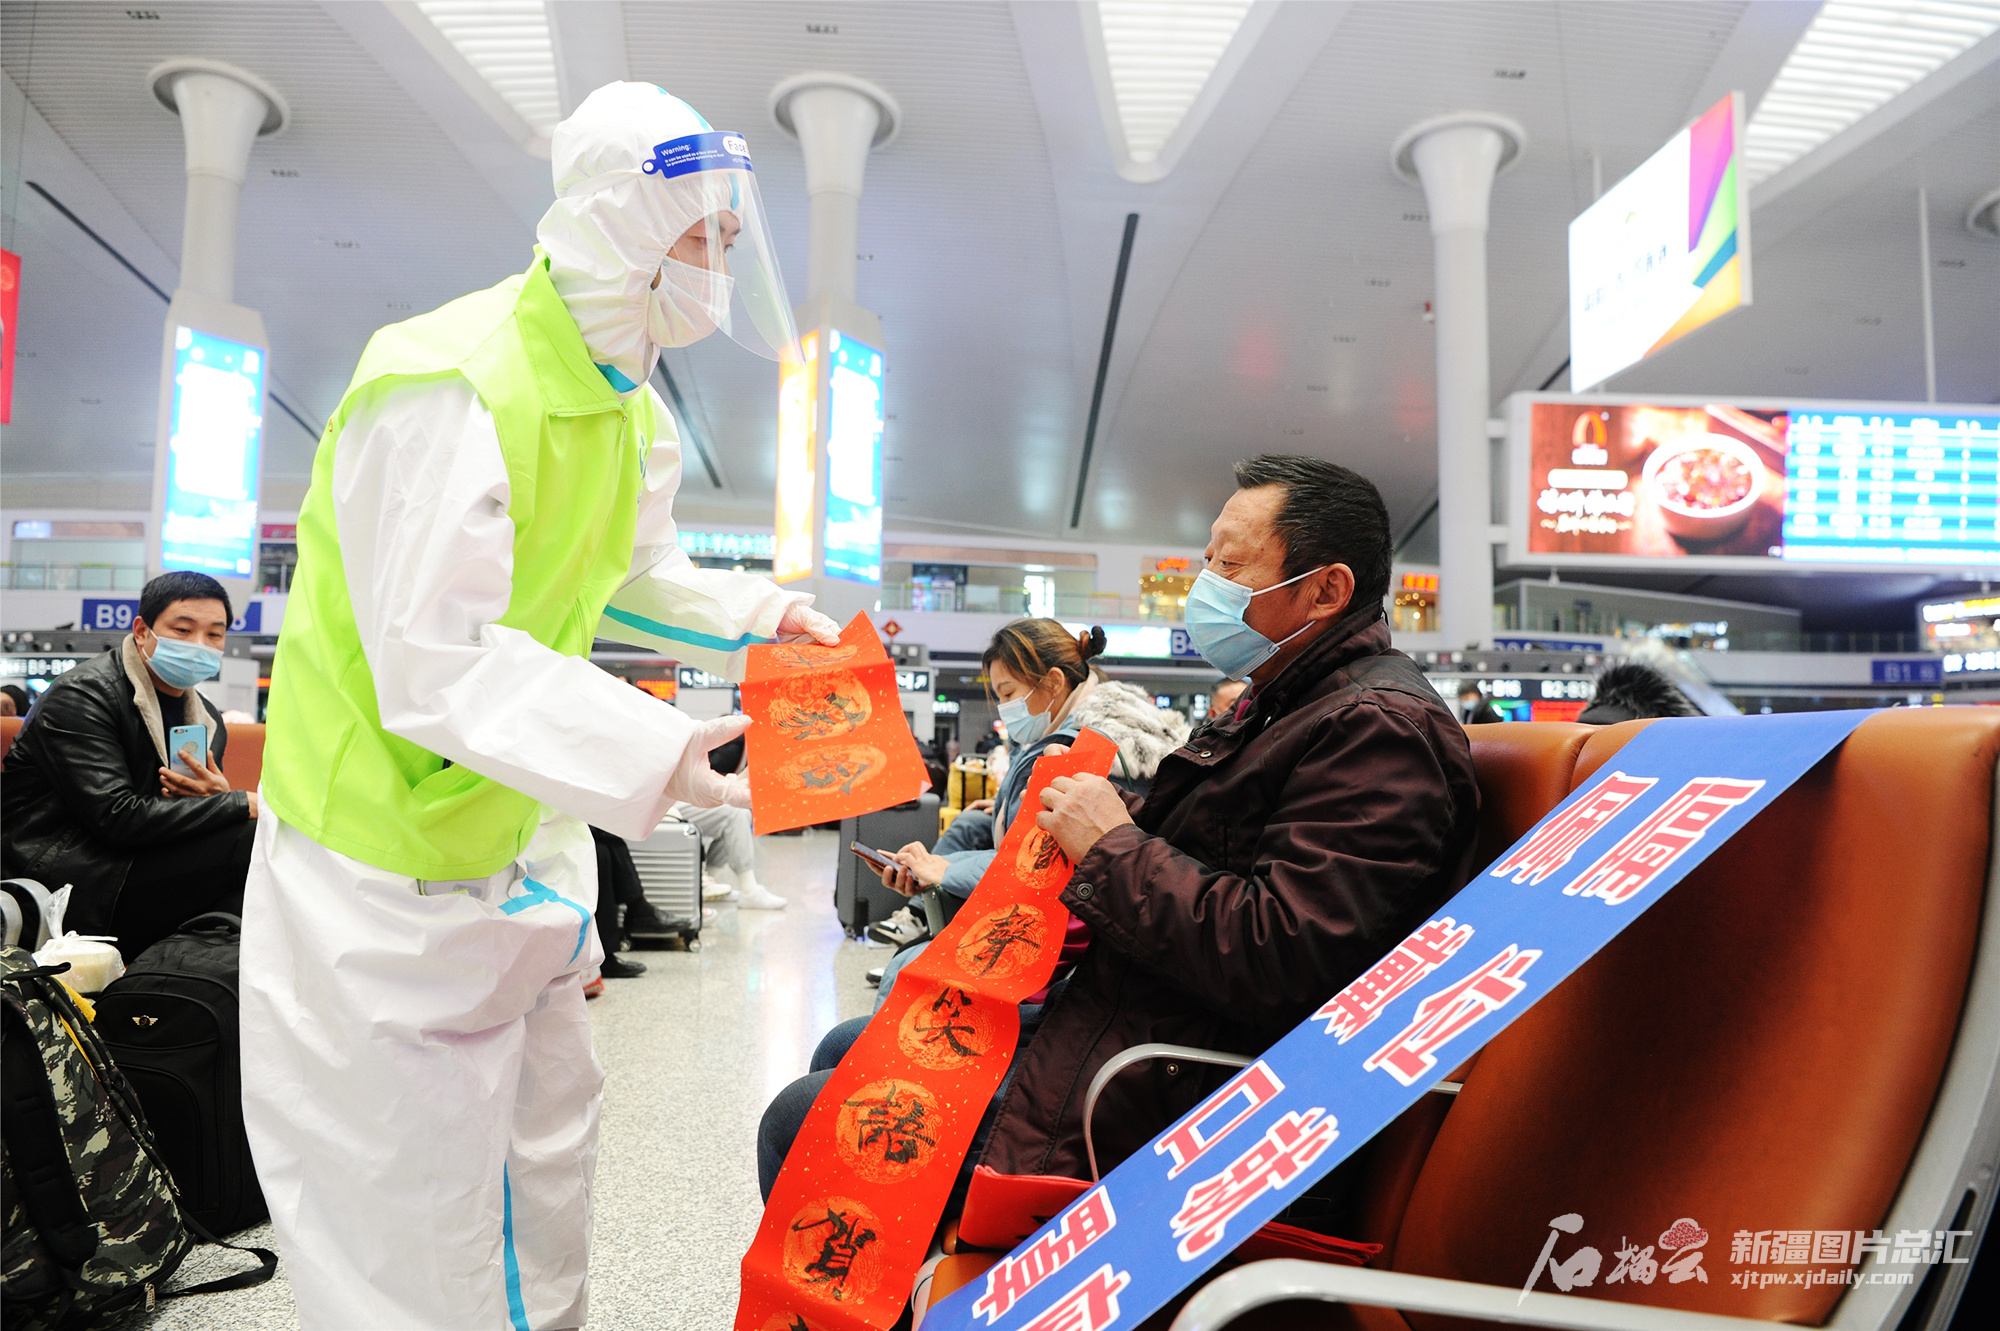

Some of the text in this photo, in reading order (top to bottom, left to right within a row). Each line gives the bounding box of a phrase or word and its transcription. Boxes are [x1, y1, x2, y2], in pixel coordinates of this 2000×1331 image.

[661, 144, 691, 157] Warning:
[96, 604, 132, 629] B9
[972, 770, 1659, 1327] 佩戴口罩
